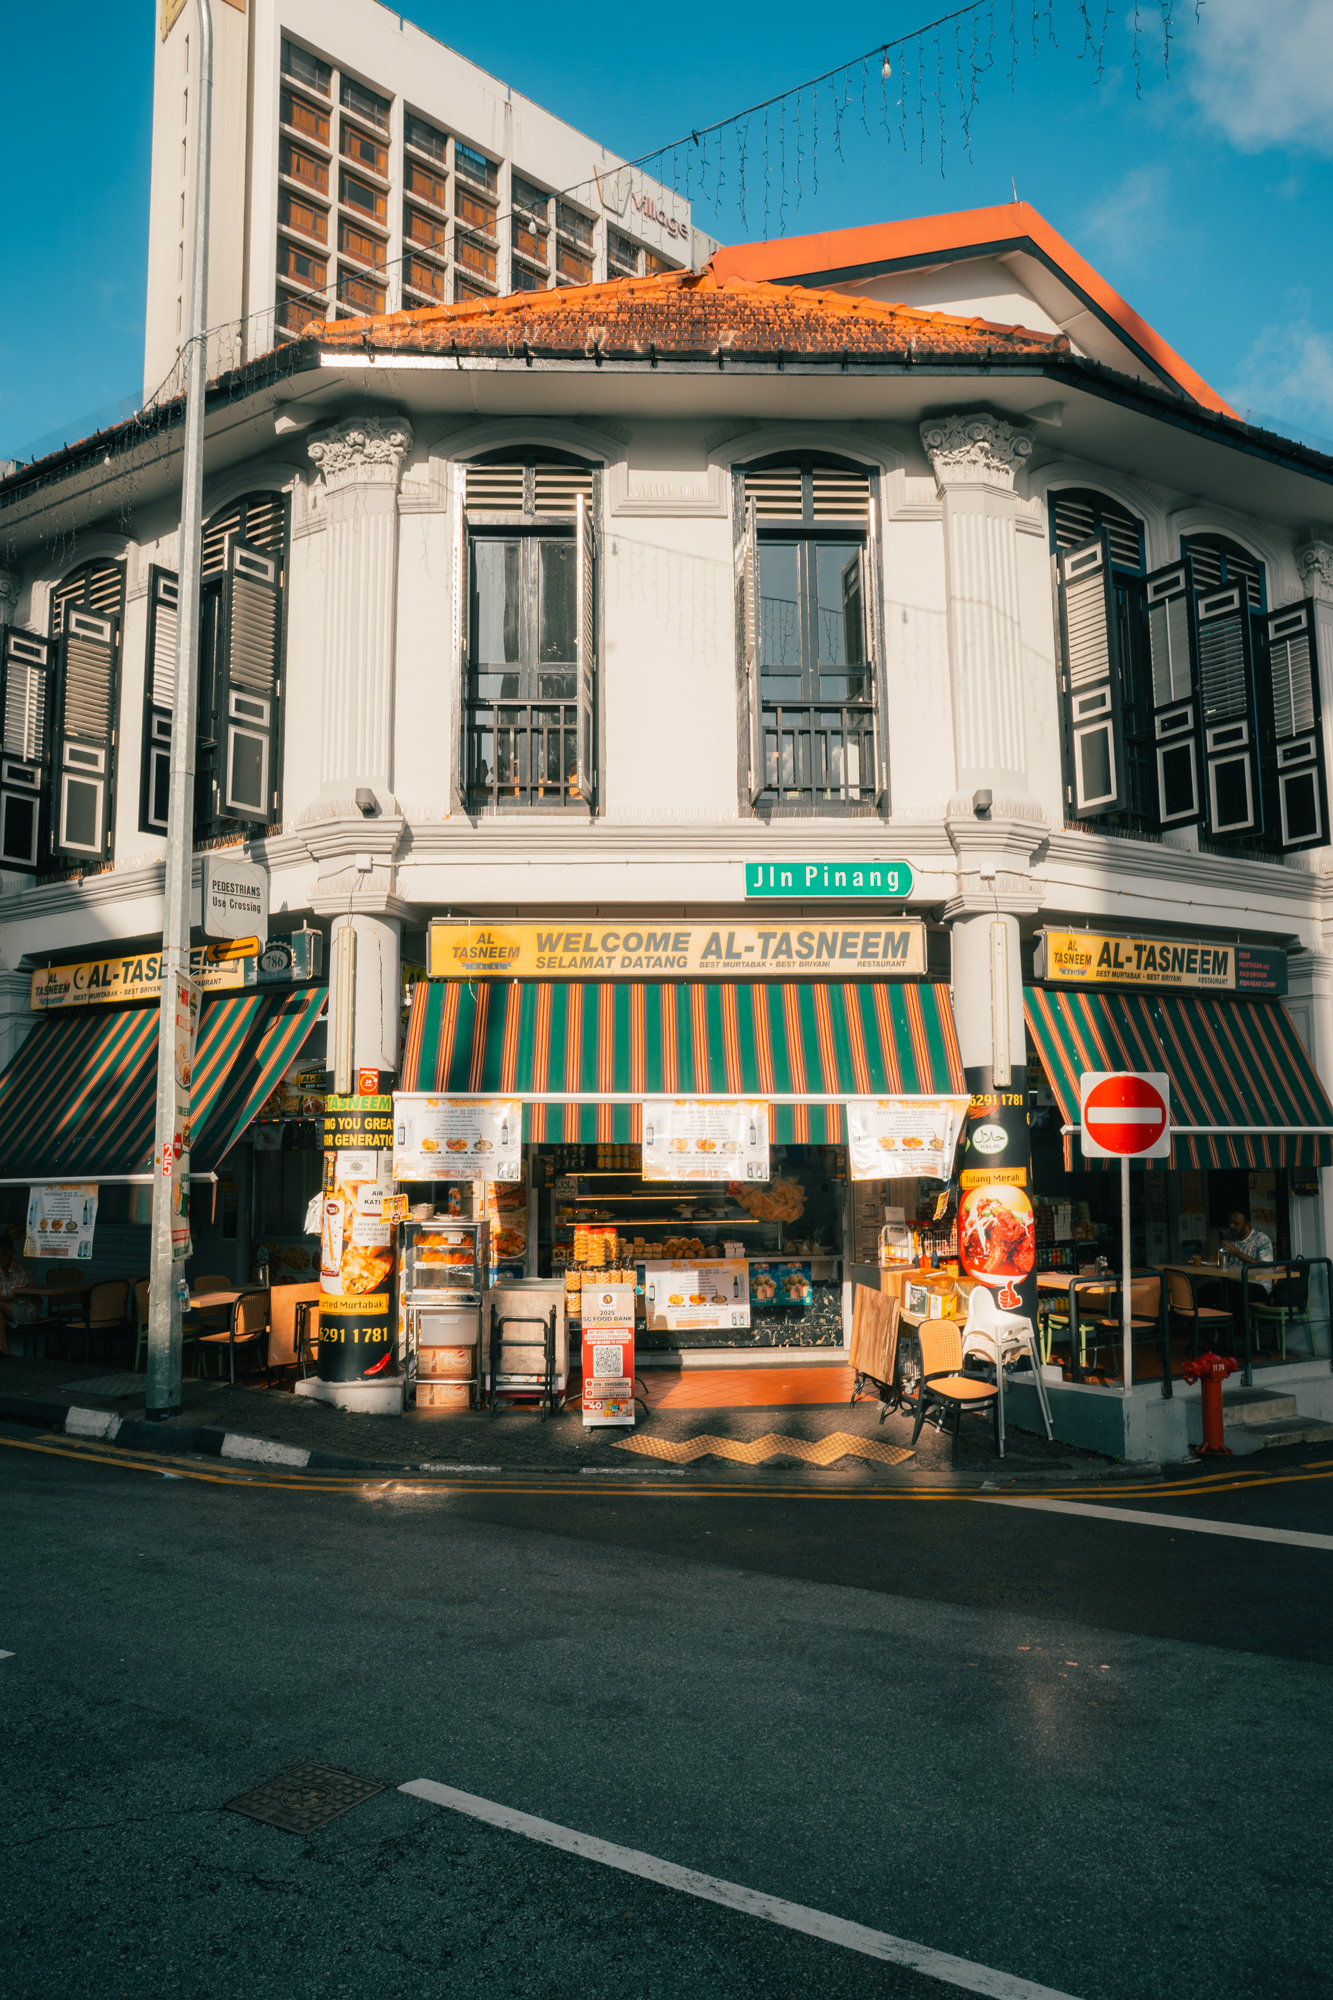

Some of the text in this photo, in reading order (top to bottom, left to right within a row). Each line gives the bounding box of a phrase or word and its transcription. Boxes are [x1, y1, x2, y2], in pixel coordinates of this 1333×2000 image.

[631, 193, 690, 240] village
[753, 866, 899, 892] Jln Pinang
[212, 880, 261, 897] PEDESTRIANS
[212, 896, 261, 915] Use Crossing
[477, 933, 494, 945] AL
[536, 931, 911, 960] WELCOME AL-TASNEEM
[1067, 940, 1078, 952] AL
[452, 946, 520, 959] TASNEEM
[1053, 952, 1092, 966] TASNEEM
[1097, 941, 1229, 976] AL-TASNEEM
[266, 954, 284, 969] 786
[535, 956, 688, 969] SELAMAT DATANG
[48, 973, 58, 984] AL
[1111, 971, 1142, 980] MURTABAK
[1146, 973, 1160, 981] BEST
[1161, 974, 1182, 983] BRIYANI
[1198, 976, 1229, 985] RESTAURANT
[36, 983, 70, 997] TASNEEM
[73, 994, 88, 1002] BEST
[88, 990, 118, 1000] MURTABAK
[123, 987, 138, 996] BEST
[139, 985, 161, 994] BRIYAN
[302, 1075, 326, 1083] AL-TA
[970, 1093, 1023, 1106] 6291 1781
[338, 1117, 361, 1130] YOU
[334, 1133, 394, 1147] GENERATIO
[974, 1129, 1006, 1143] حلال
[966, 1174, 1020, 1184] Tulang Merah
[340, 1300, 384, 1309] Murtabak
[319, 1327, 388, 1343] 6291 1781
[588, 1401, 602, 1409] 40
